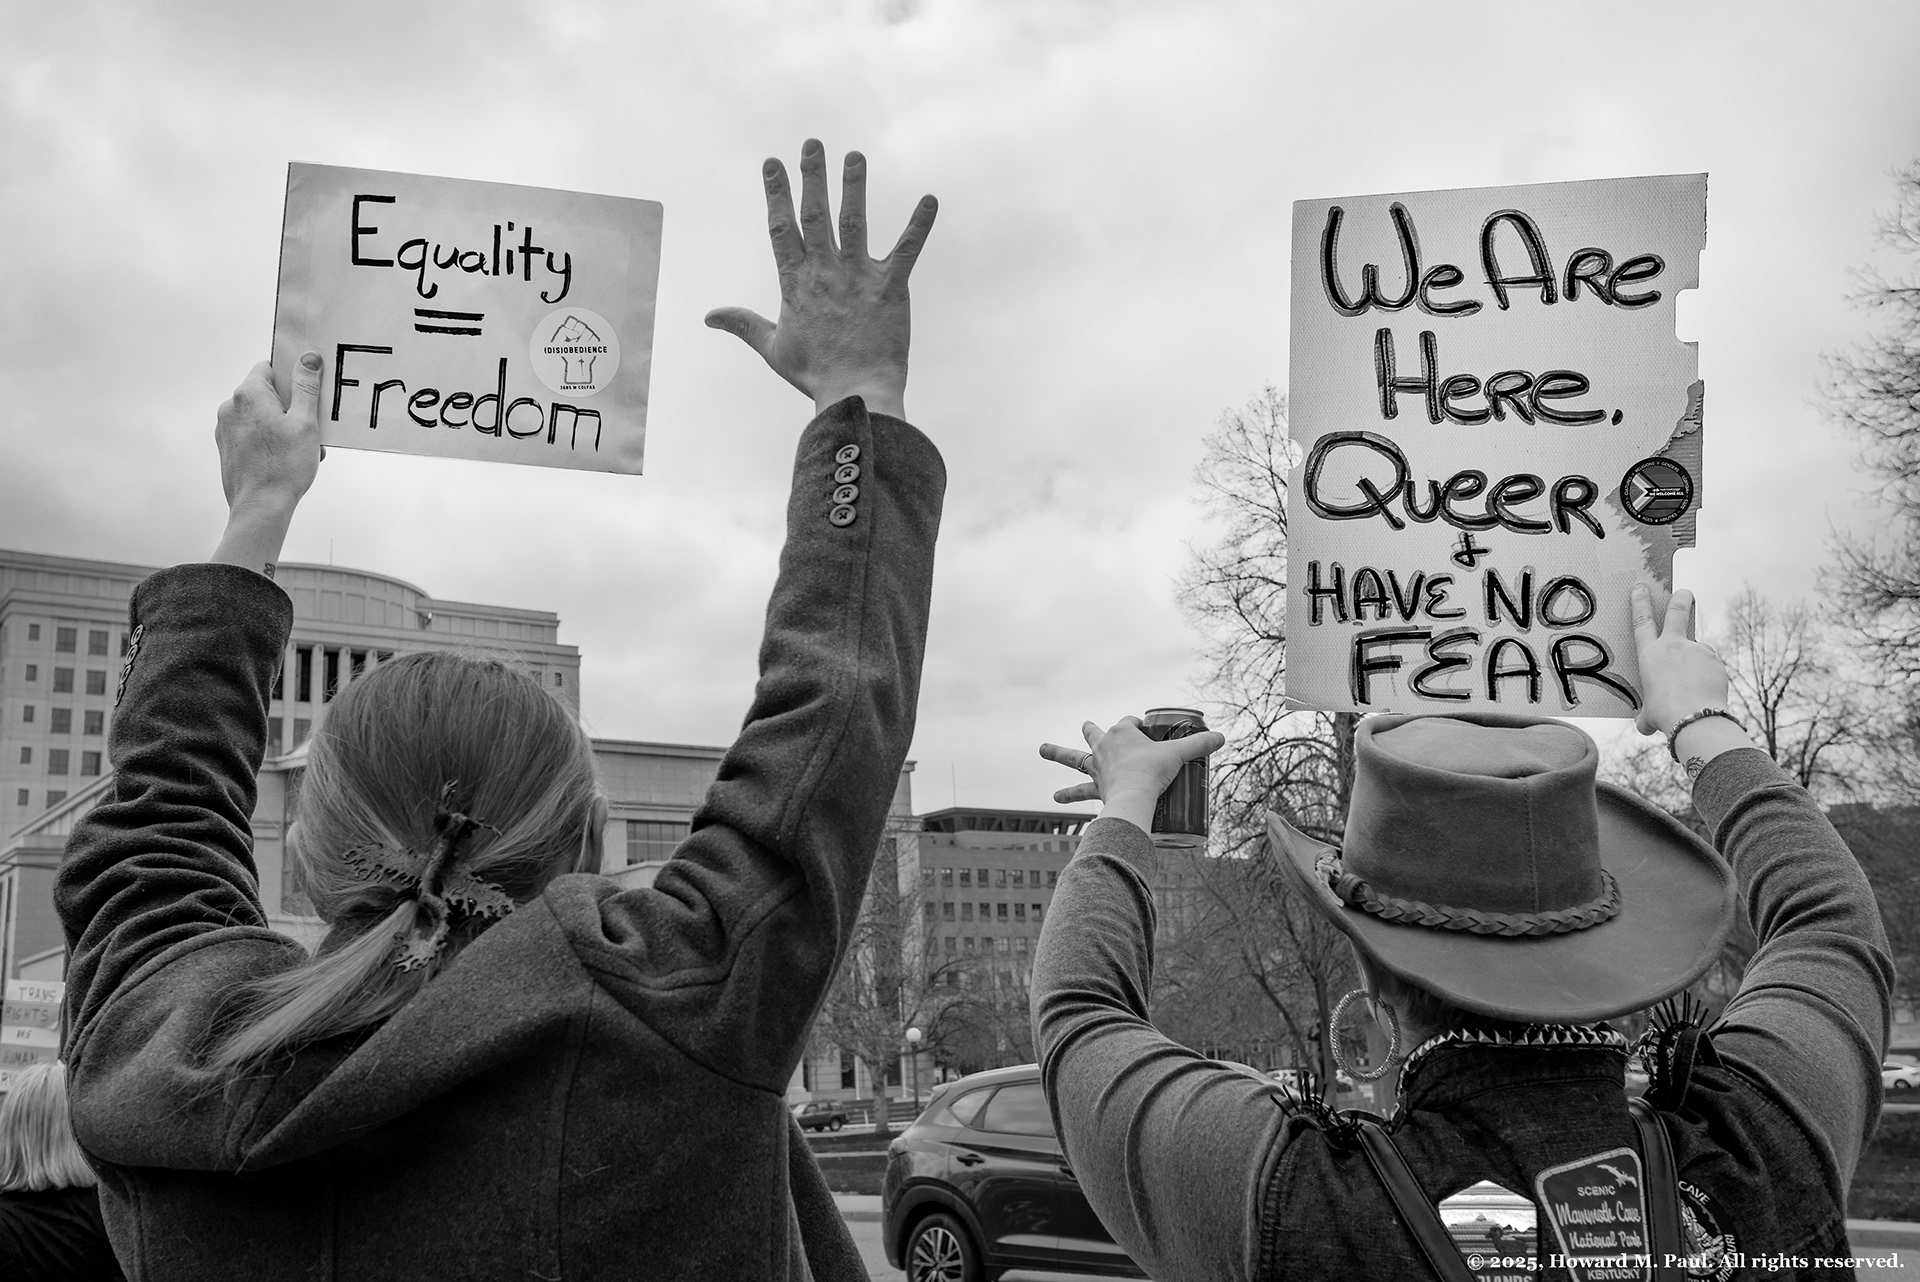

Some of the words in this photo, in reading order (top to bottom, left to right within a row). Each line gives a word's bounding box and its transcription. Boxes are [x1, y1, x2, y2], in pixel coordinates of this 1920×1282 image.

[351, 194, 572, 304] Equality
[1319, 201, 1483, 318] We
[331, 343, 602, 453] Freedom
[1304, 560, 1466, 627] HAVE
[1482, 565, 1597, 634] NO
[1348, 625, 1643, 711] FEAR
[5, 1006, 49, 1022] RIGHTS
[1577, 1185, 1616, 1197] SCENIC
[1678, 1181, 1711, 1205] CAVE
[1555, 1200, 1616, 1227] Mammoth
[1616, 1200, 1641, 1223] Cave
[1568, 1230, 1618, 1249] National
[1618, 1230, 1642, 1248] Park
[1587, 1269, 1641, 1280] KENTUCKY
